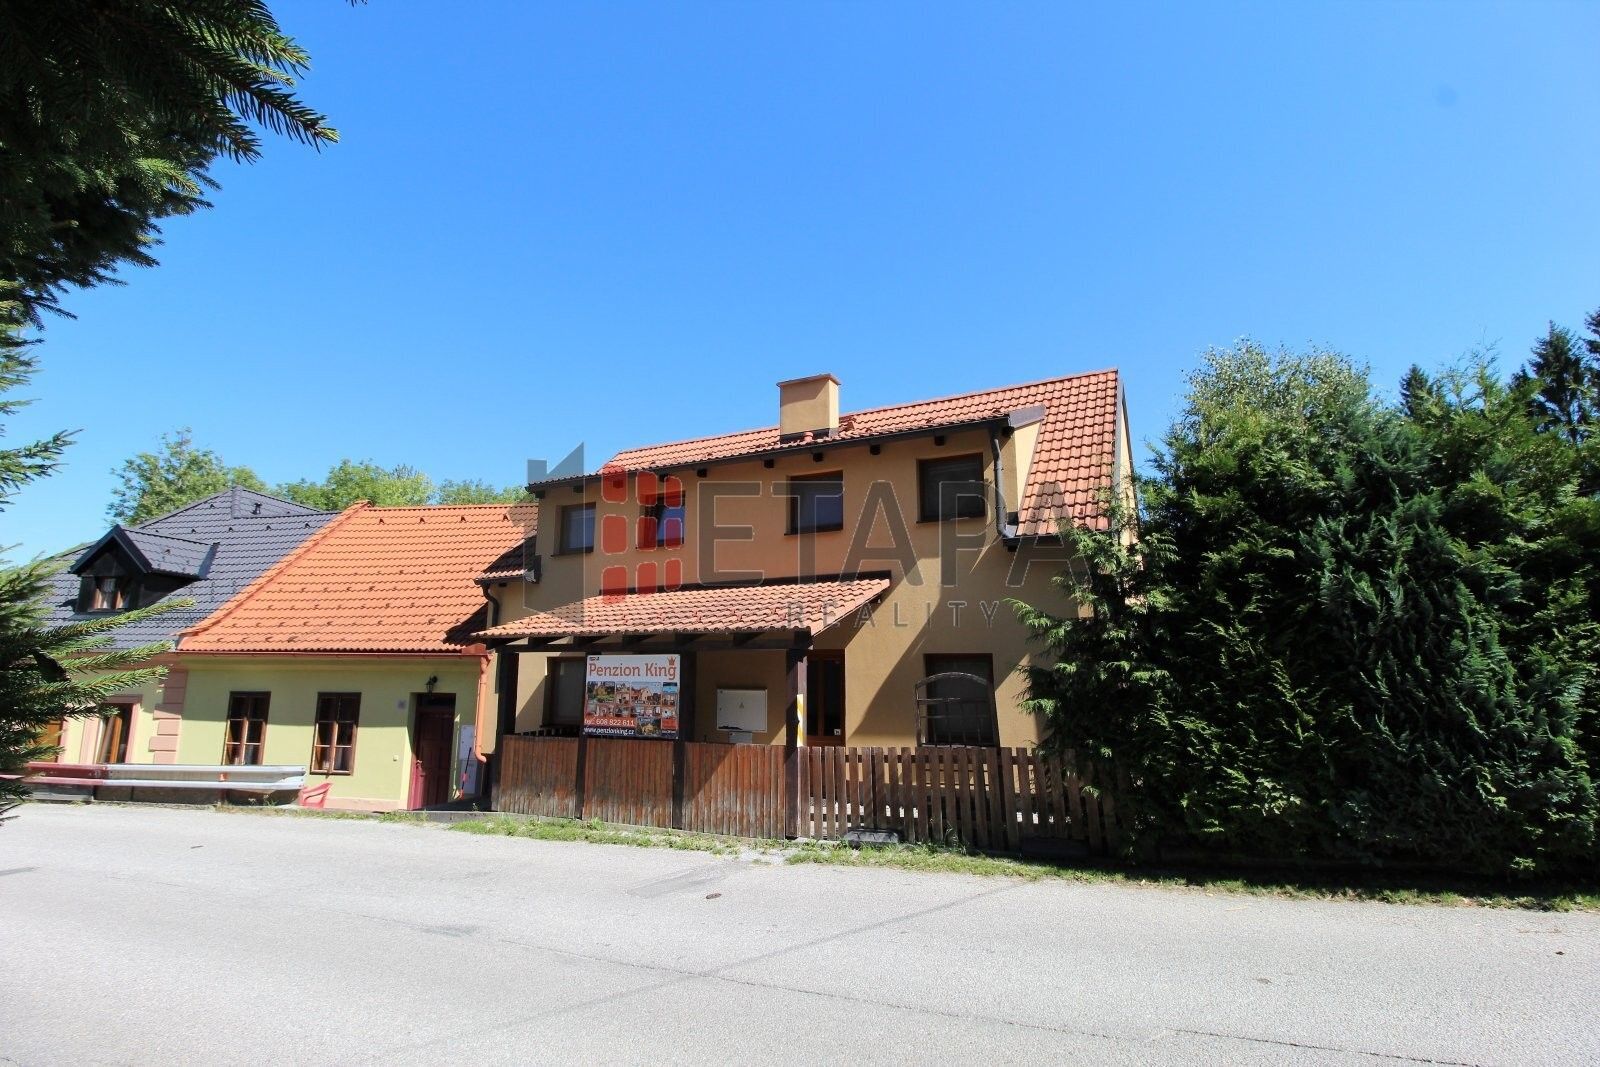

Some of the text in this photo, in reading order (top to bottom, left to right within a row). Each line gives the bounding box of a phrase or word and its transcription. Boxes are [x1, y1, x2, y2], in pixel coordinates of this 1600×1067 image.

[589, 662, 677, 680] Penzion King
[584, 726, 635, 736] www.penzionking.cz
